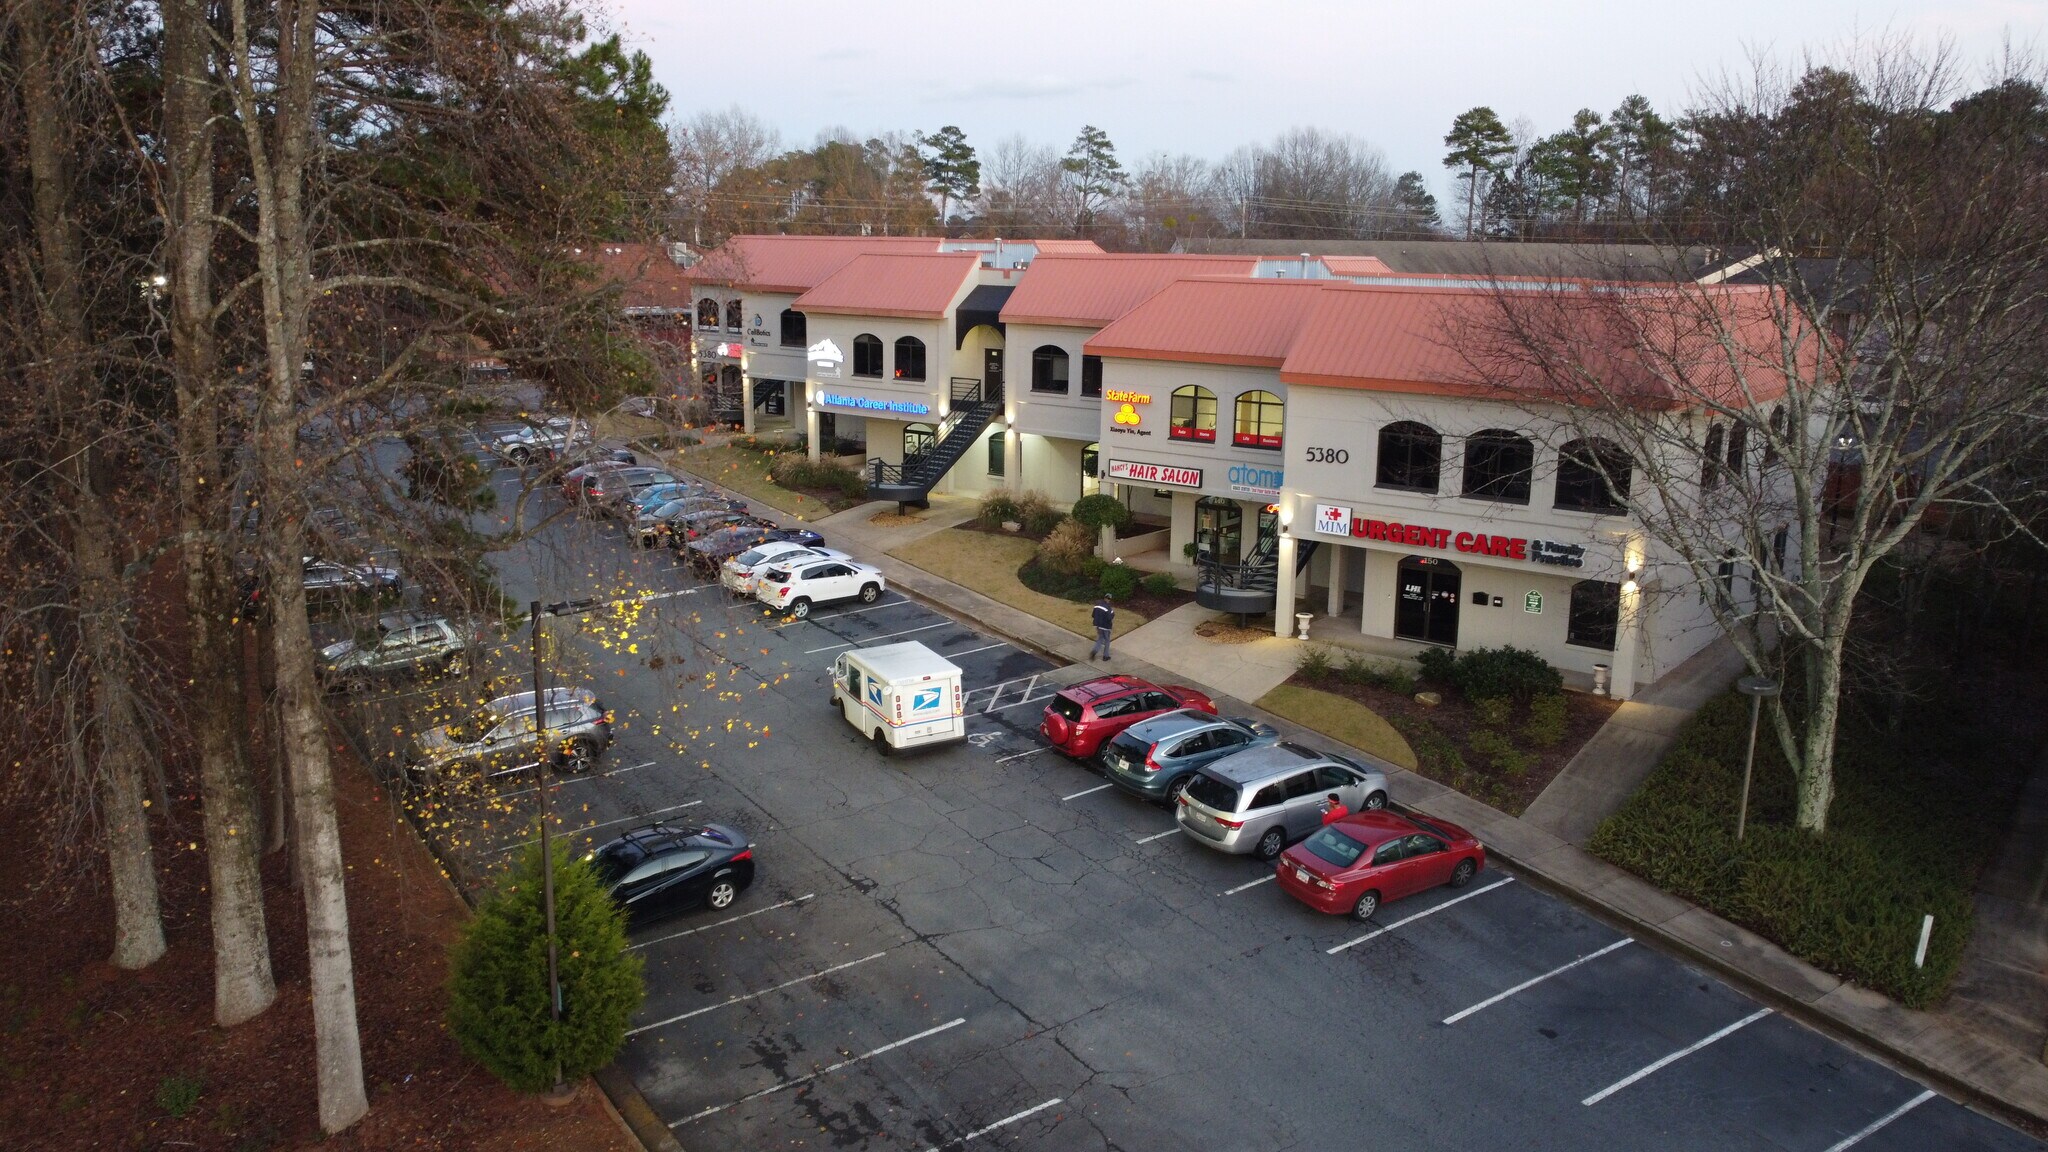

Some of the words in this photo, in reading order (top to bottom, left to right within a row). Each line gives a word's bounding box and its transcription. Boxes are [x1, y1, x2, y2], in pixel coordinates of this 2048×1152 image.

[825, 394, 856, 407] Atlanta
[857, 397, 888, 411] Career
[889, 401, 929, 415] Institute
[1137, 429, 1151, 437] Agent
[1306, 447, 1349, 464] 5380
[1111, 463, 1128, 473] NANCY'S
[1129, 464, 1158, 481] HAIR
[1161, 467, 1199, 485] SALON
[1317, 520, 1348, 535] MIM
[1352, 517, 1452, 549] URGENT
[1455, 531, 1528, 561] CARE
[1531, 539, 1543, 551] &
[1545, 541, 1586, 559] Family
[1531, 550, 1584, 568] Practice
